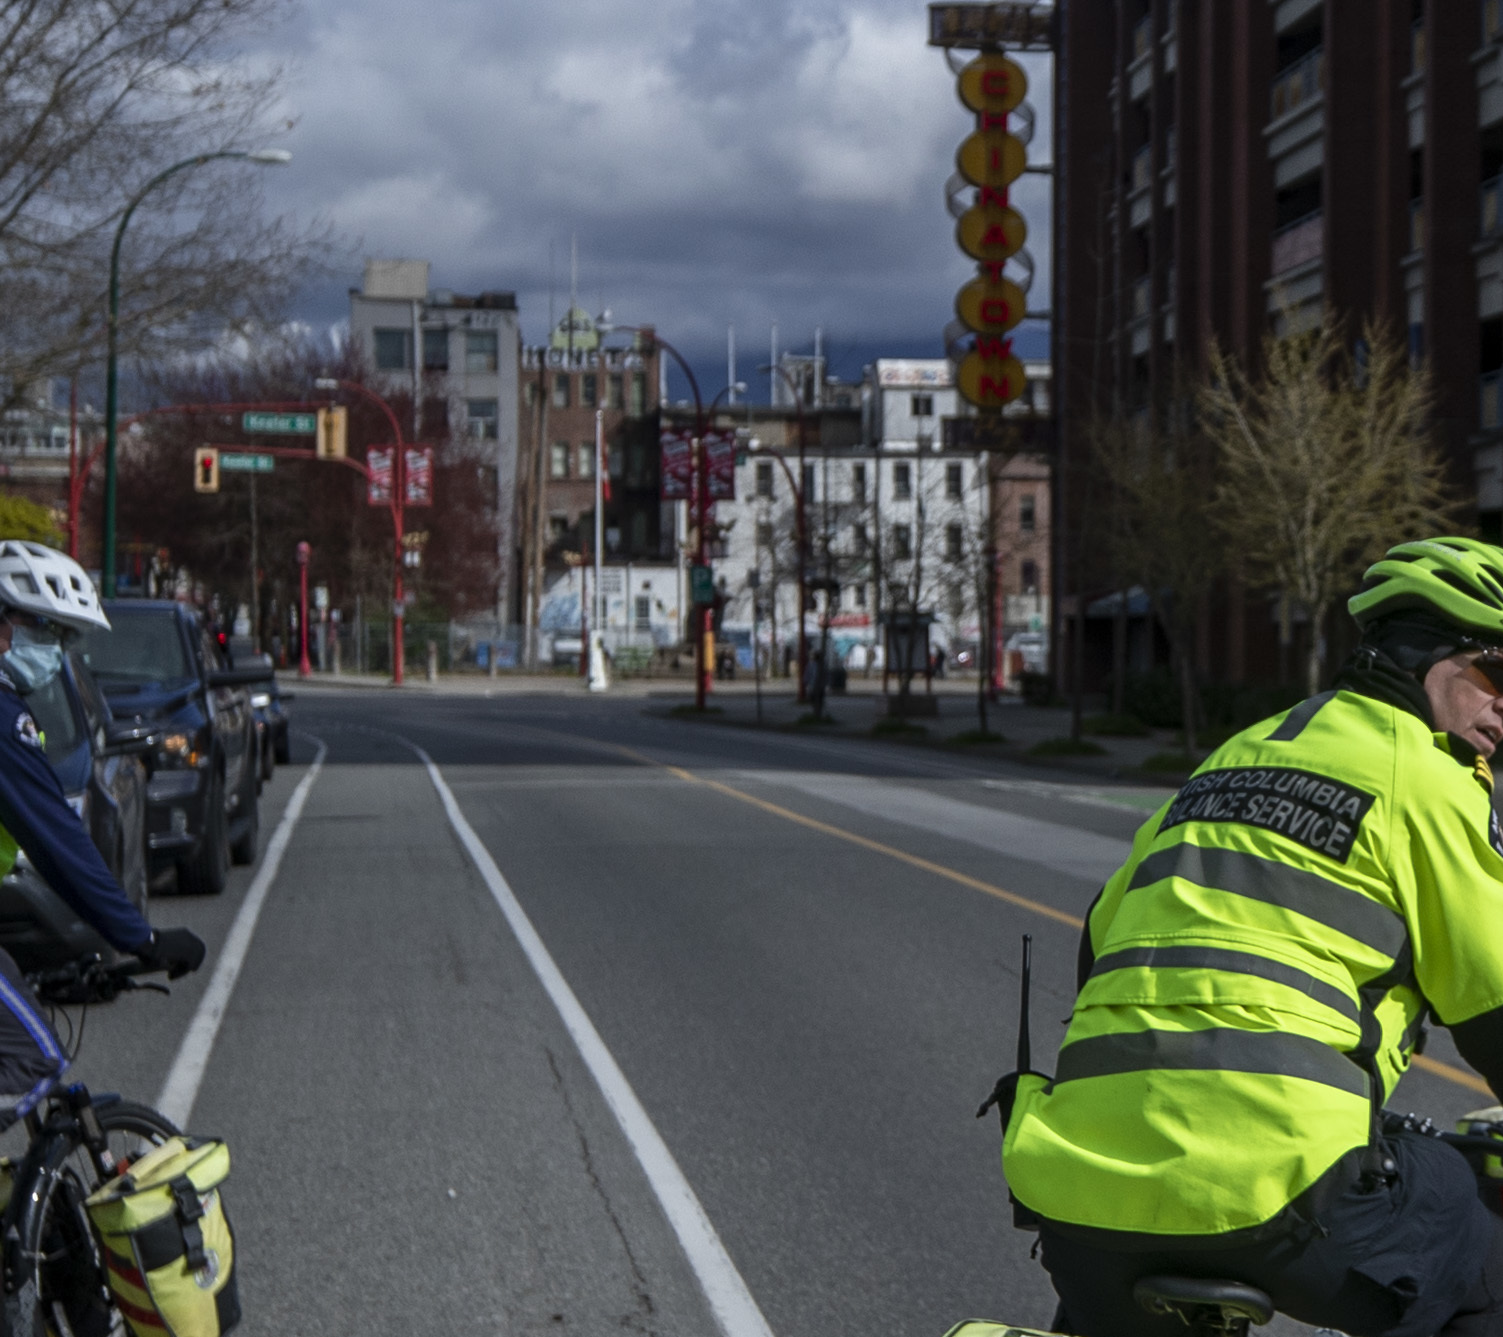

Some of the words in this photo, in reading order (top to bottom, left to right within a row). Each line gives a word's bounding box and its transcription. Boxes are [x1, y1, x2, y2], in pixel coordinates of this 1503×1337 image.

[975, 69, 1014, 399] CHINATOWN
[1229, 770, 1362, 821] COLUMBIA
[1240, 794, 1352, 857] SERVICE
